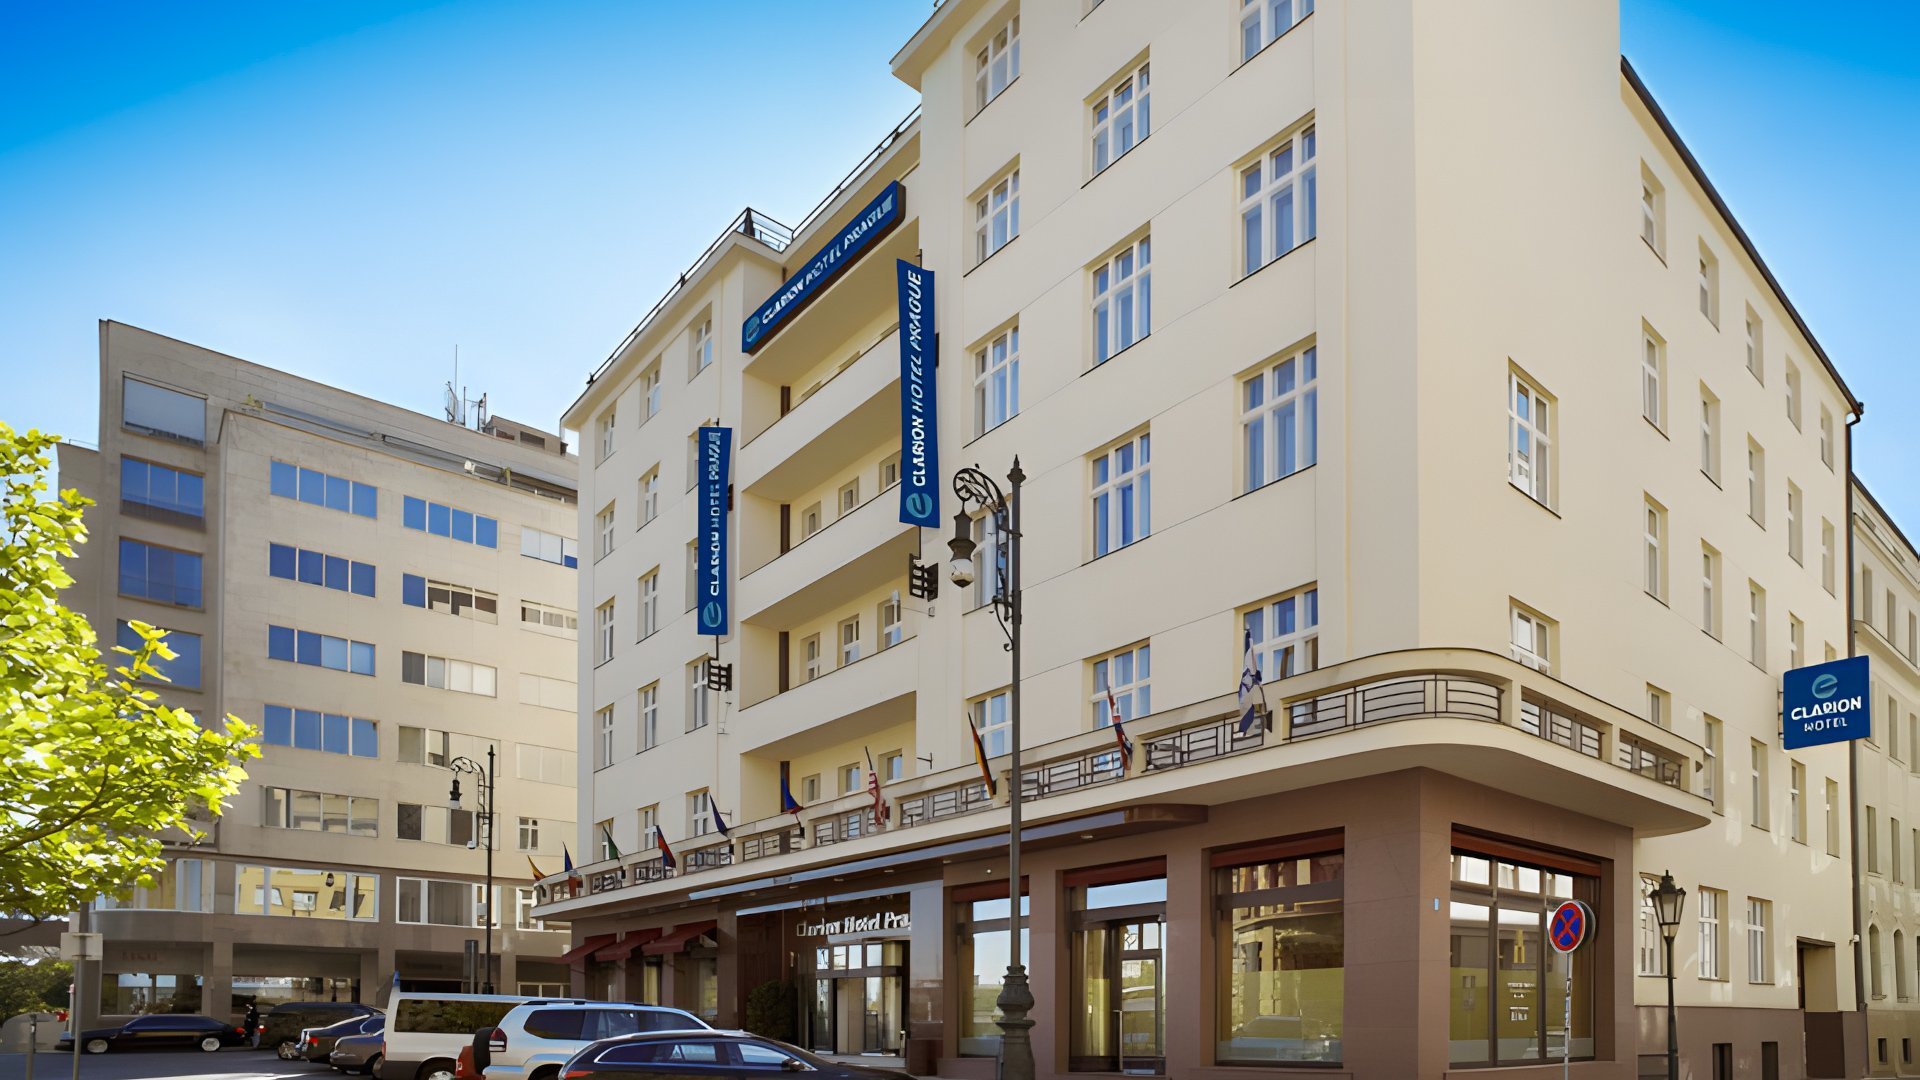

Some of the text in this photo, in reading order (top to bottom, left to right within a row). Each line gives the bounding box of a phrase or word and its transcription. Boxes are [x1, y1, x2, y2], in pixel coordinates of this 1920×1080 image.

[910, 354, 923, 413] HOTEL
[911, 418, 925, 487] CLARION
[1791, 696, 1862, 721] CLARION
[1804, 717, 1848, 732] HOTEL
